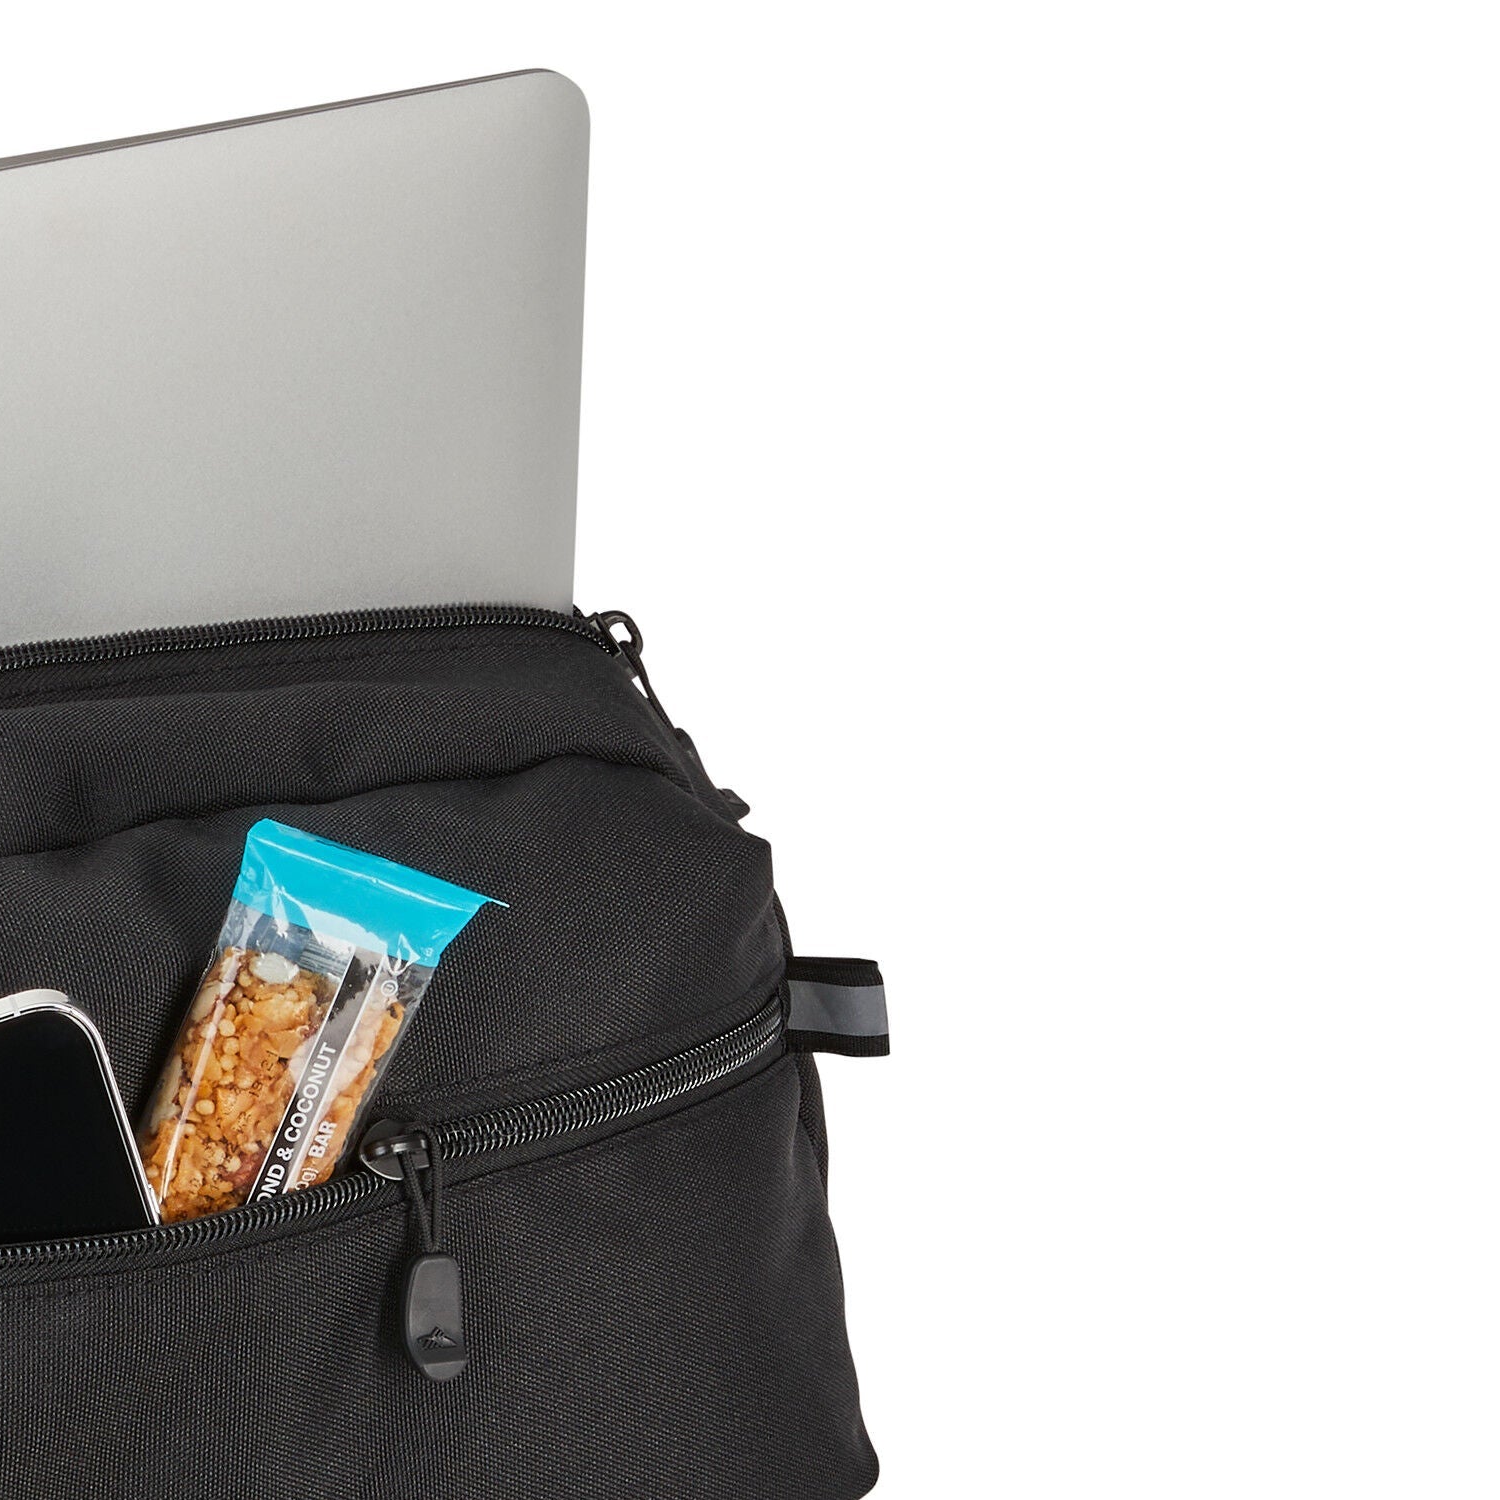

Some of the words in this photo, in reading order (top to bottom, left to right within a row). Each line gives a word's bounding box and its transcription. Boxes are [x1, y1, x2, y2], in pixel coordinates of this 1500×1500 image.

[284, 1041, 337, 1142] COCONUT
[276, 1147, 295, 1161] &
[308, 1121, 338, 1158] BAR
